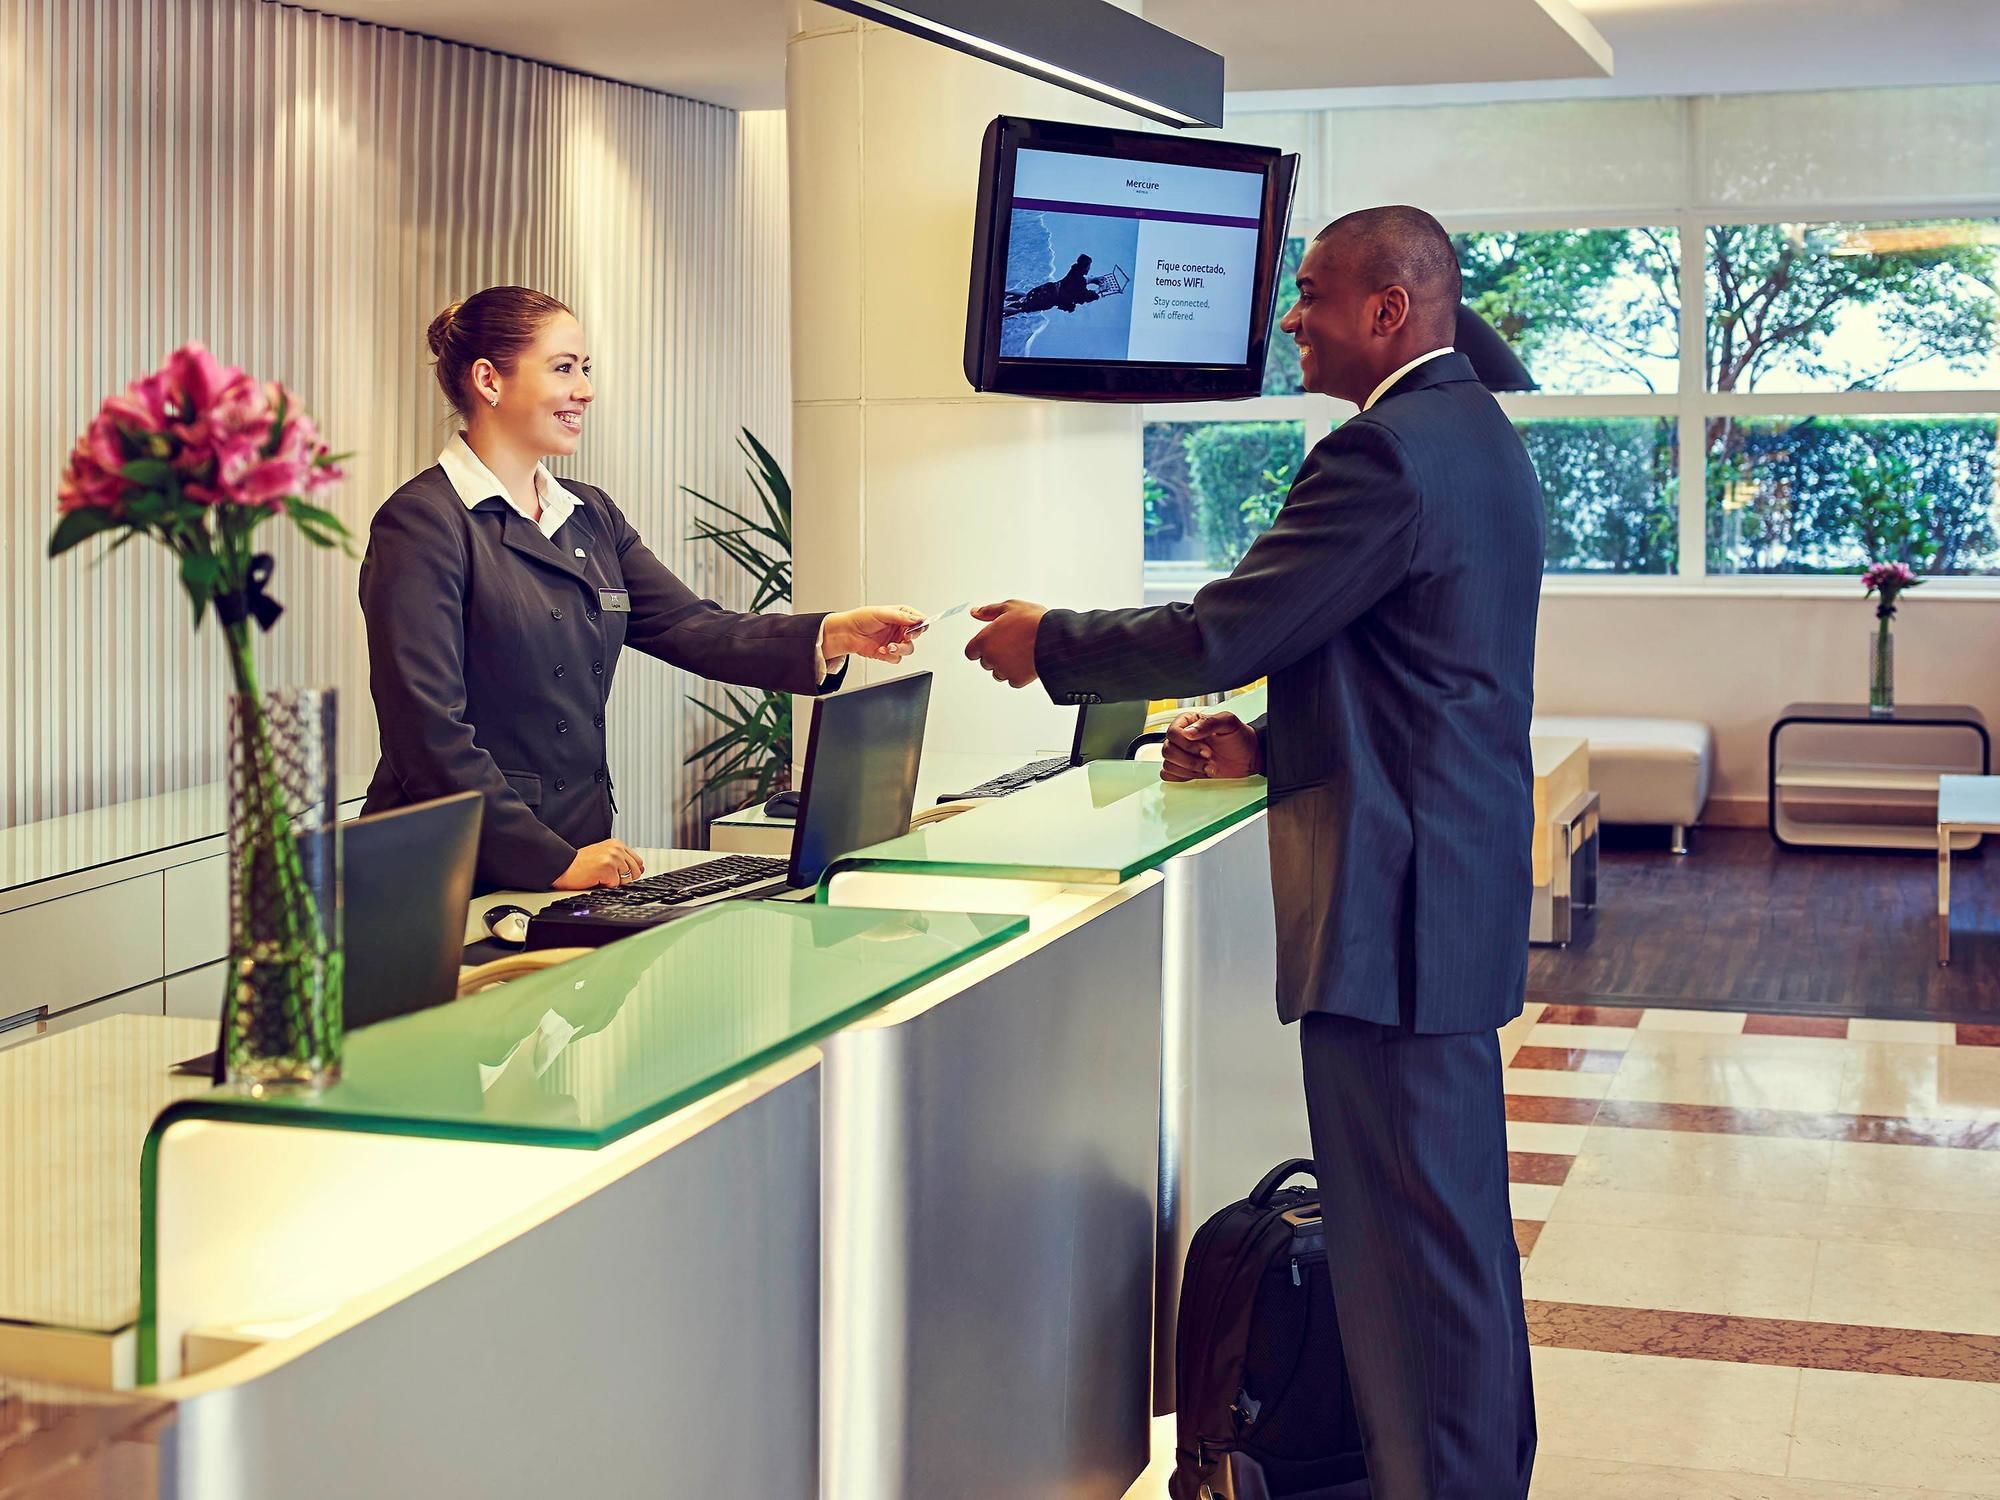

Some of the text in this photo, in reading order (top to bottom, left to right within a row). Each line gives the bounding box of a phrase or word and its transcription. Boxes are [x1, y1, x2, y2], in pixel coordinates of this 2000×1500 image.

[1126, 179, 1160, 190] Mercure
[1156, 259, 1226, 275] Fique conectado,
[1155, 277, 1182, 287] temos
[1153, 296, 1211, 309] Stay connected,
[1152, 310, 1166, 320] wifi
